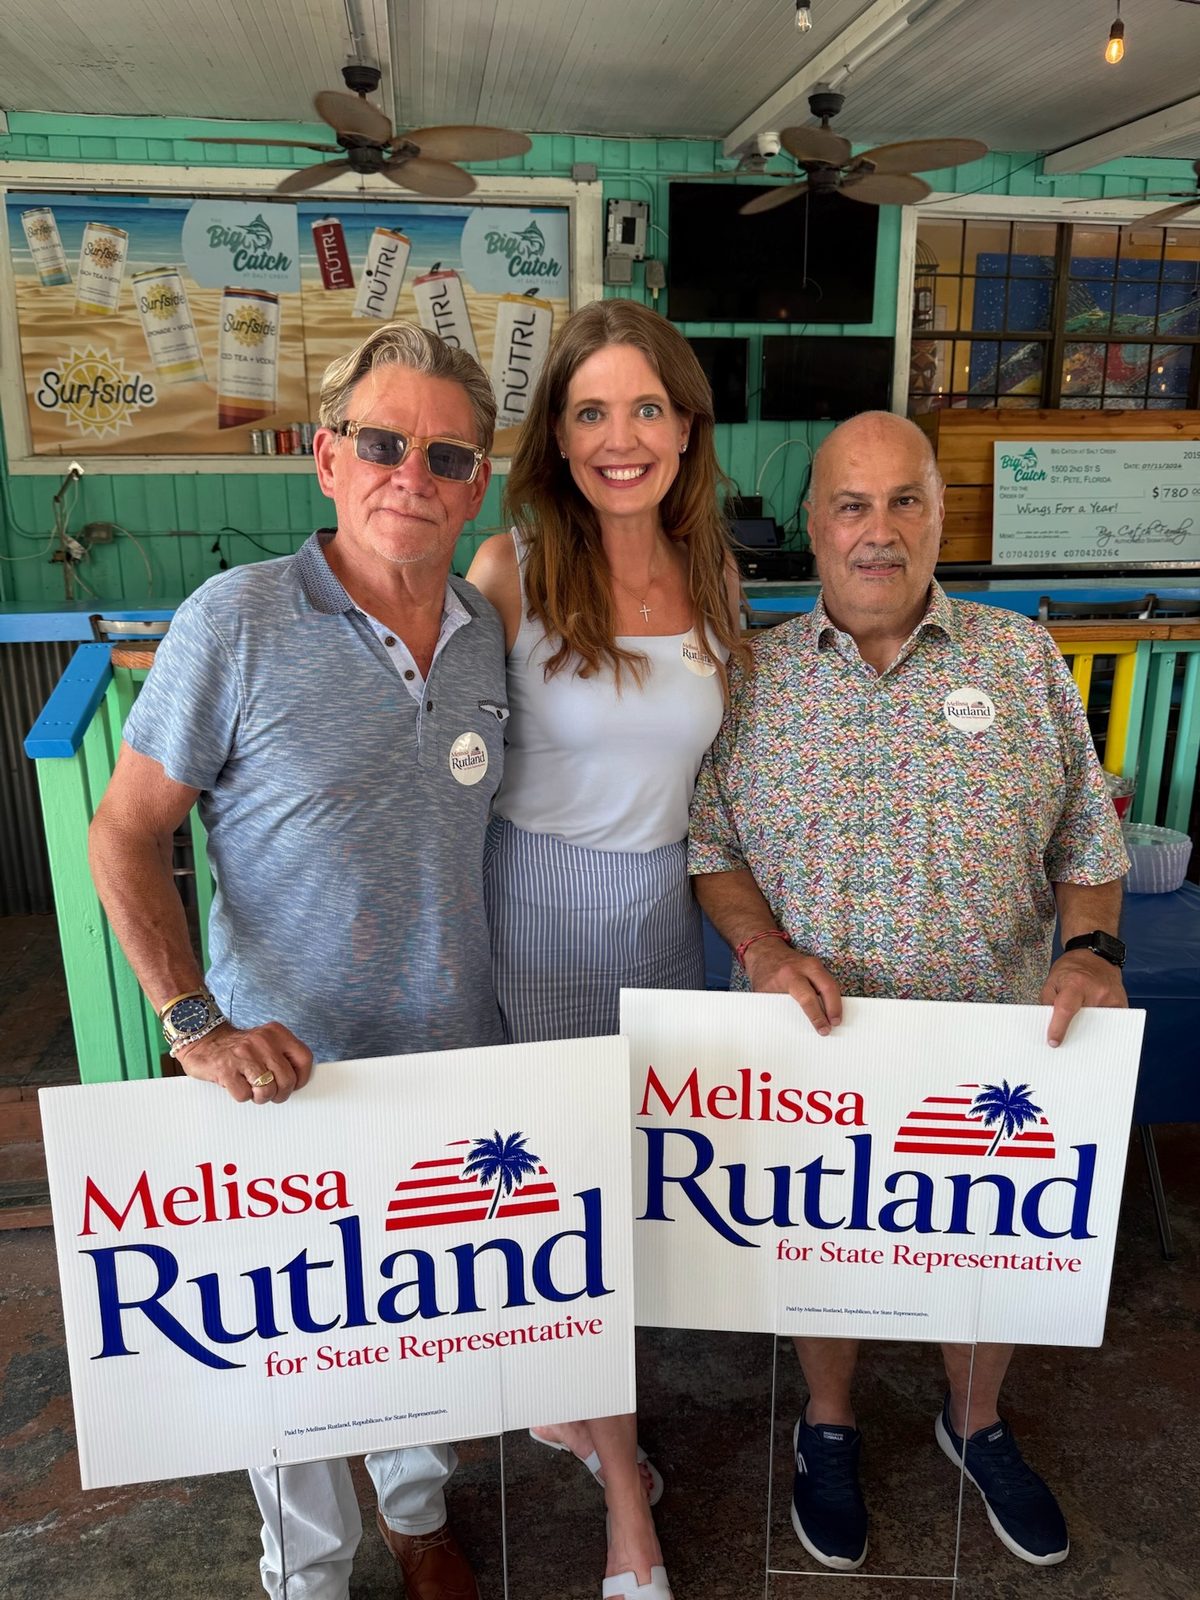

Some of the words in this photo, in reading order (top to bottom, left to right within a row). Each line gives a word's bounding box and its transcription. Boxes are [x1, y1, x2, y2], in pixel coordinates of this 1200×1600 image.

[206, 224, 244, 254] Big
[484, 232, 518, 258] Big
[233, 249, 292, 272] Catch
[508, 256, 562, 277] Catch
[224, 314, 276, 336] Surfside
[38, 372, 155, 408] Surfside
[1000, 455, 1022, 471] Big
[1014, 468, 1048, 482] Catch
[1163, 488, 1188, 498] 780
[1017, 503, 1051, 516] Wings
[1055, 503, 1075, 514] For
[1090, 502, 1118, 513] Year!
[947, 706, 991, 717] Rutland
[452, 751, 485, 770] Rutland
[637, 1065, 868, 1126] Melissa
[77, 1162, 353, 1236] Melissa
[636, 1127, 1098, 1248] Rutland
[776, 1239, 812, 1262] for
[820, 1241, 884, 1264] State
[892, 1244, 1082, 1273] Representative
[78, 1188, 615, 1370] Rutland
[266, 1351, 308, 1377] for
[316, 1344, 390, 1371] State
[398, 1316, 603, 1364] Representative
